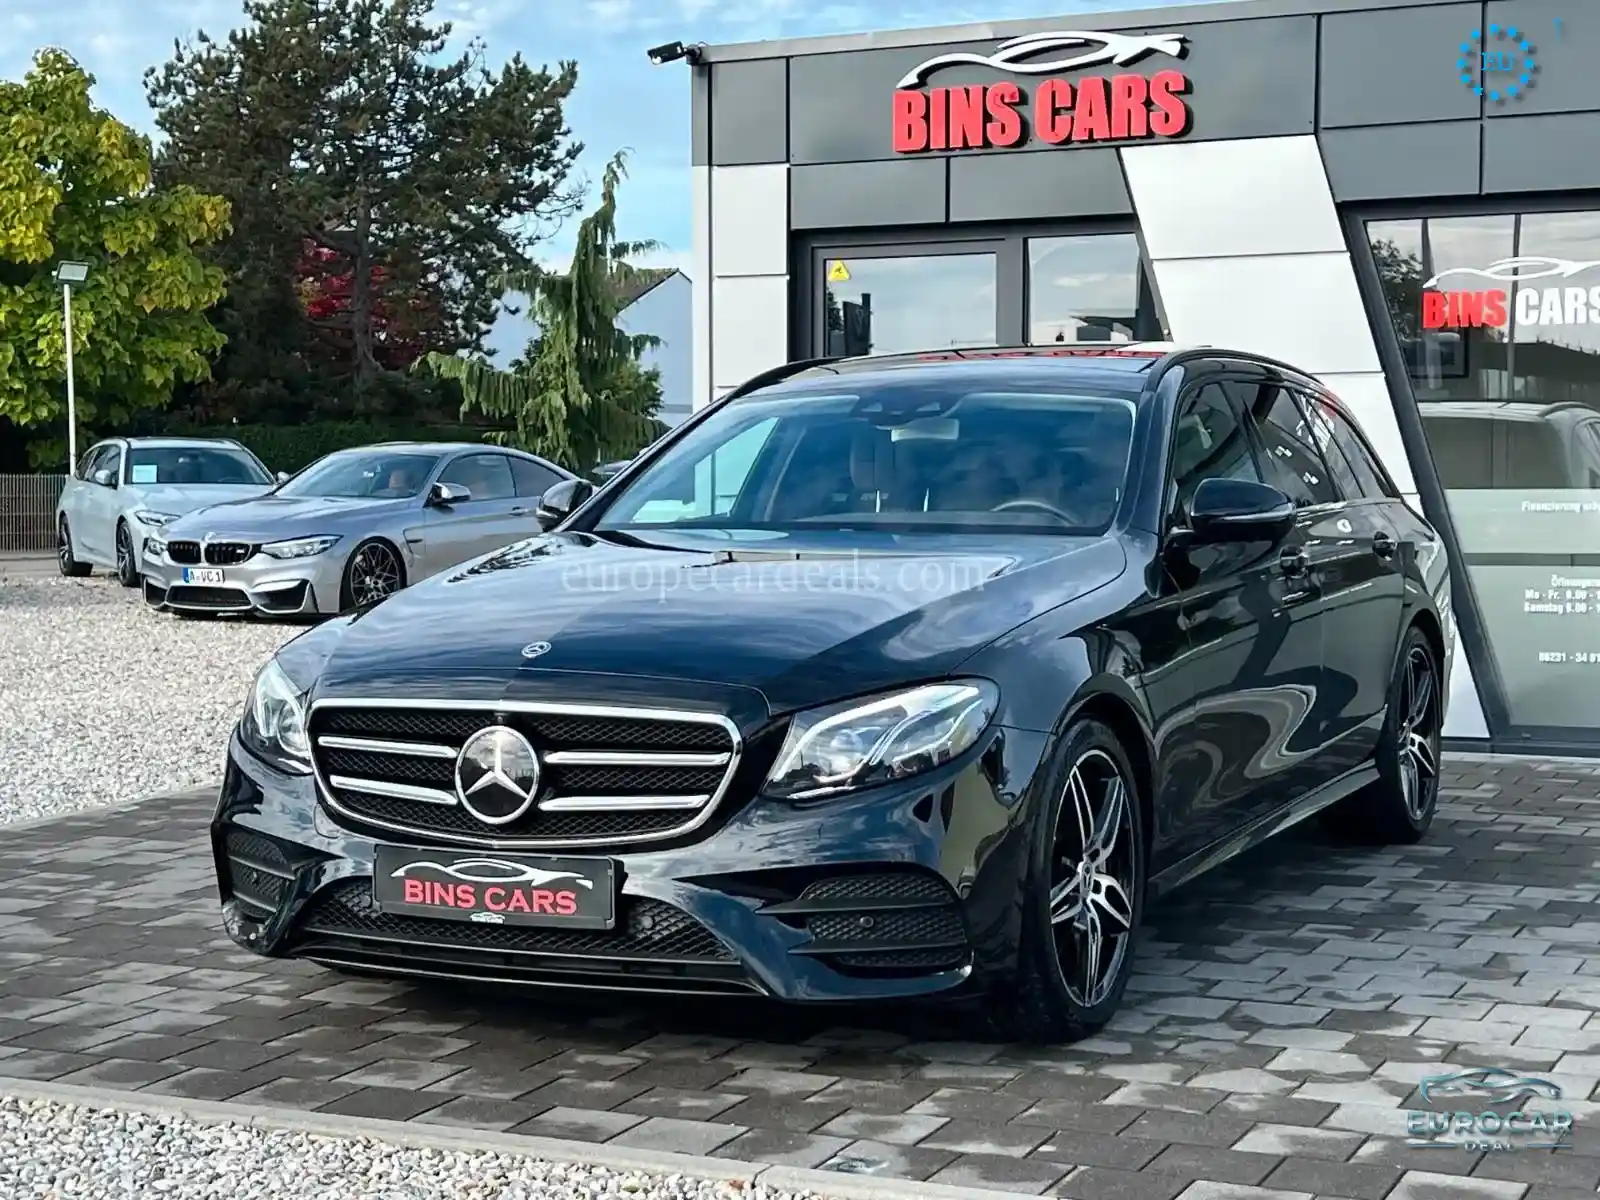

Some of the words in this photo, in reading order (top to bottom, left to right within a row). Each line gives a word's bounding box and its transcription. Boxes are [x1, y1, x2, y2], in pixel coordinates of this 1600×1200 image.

[893, 81, 1022, 153] BINS
[1034, 69, 1188, 146] CARS
[1422, 288, 1508, 329] BINS
[403, 878, 477, 909] BINS
[483, 886, 578, 915] CARS
